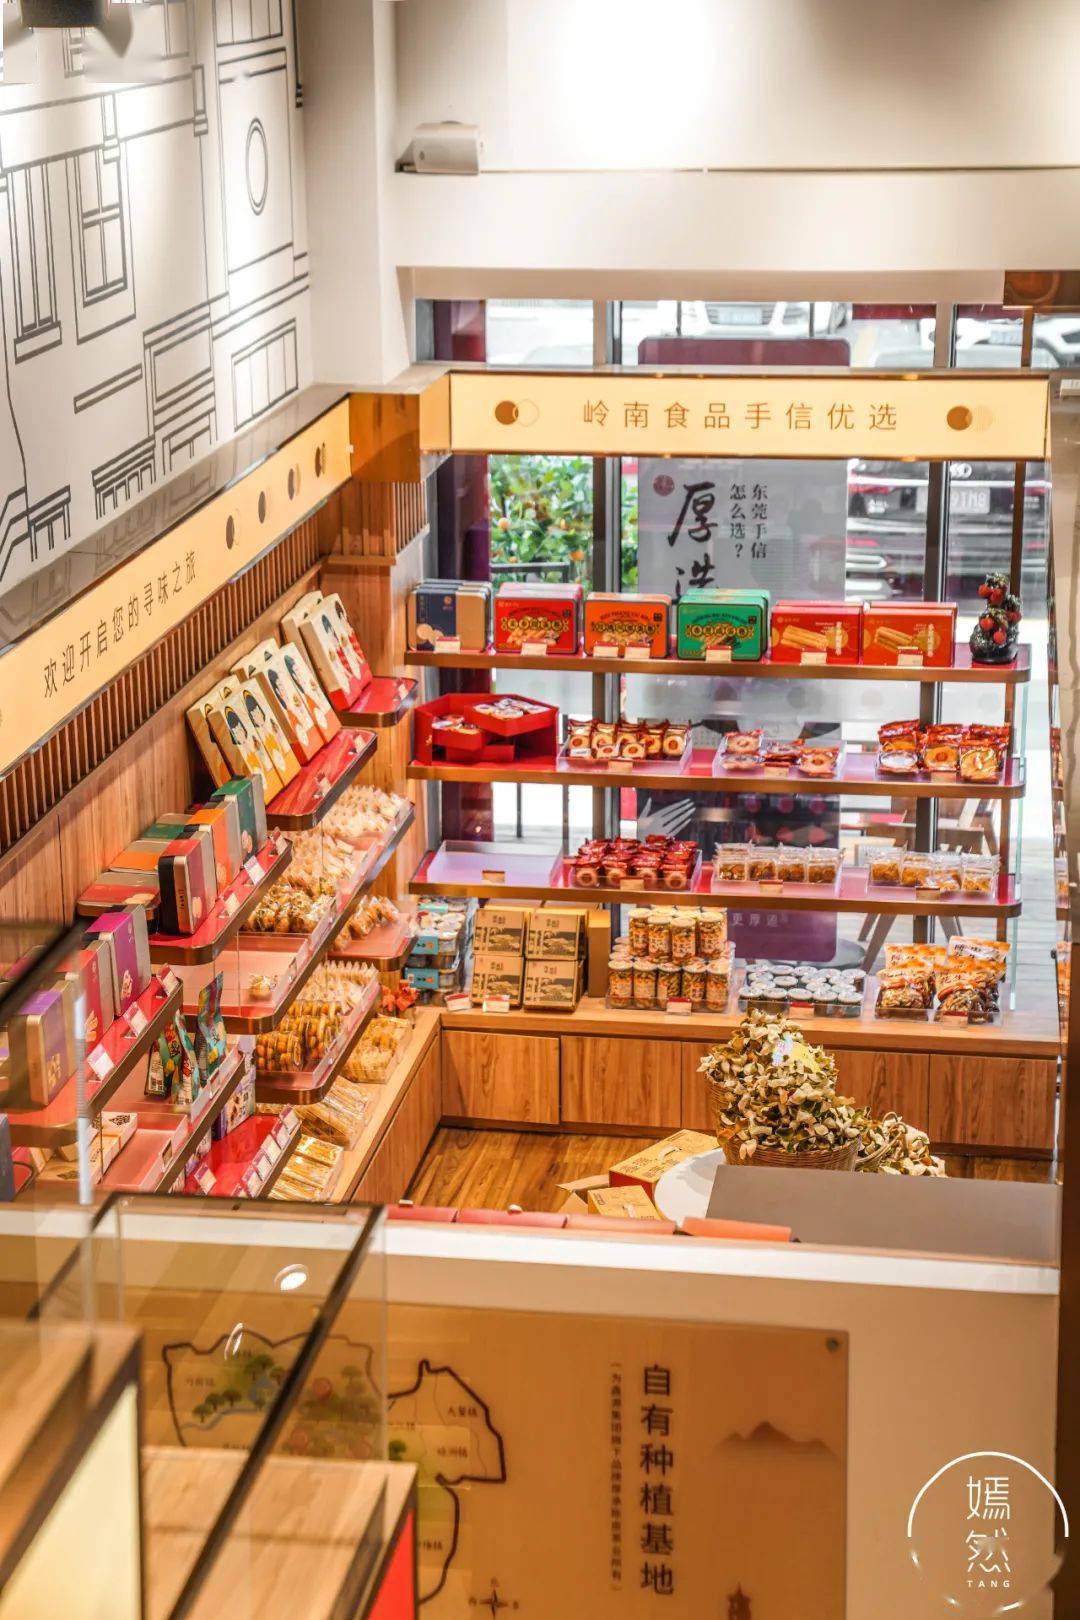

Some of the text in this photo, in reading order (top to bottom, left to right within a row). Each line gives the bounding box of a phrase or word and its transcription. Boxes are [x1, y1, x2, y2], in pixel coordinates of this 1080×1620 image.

[583, 399, 898, 431] 岭南食品手信优选
[751, 483, 769, 560] 东莞手信
[43, 551, 196, 698] 欢迎开启您的寻味之旅
[639, 1363, 675, 1596] 自有种植基地
